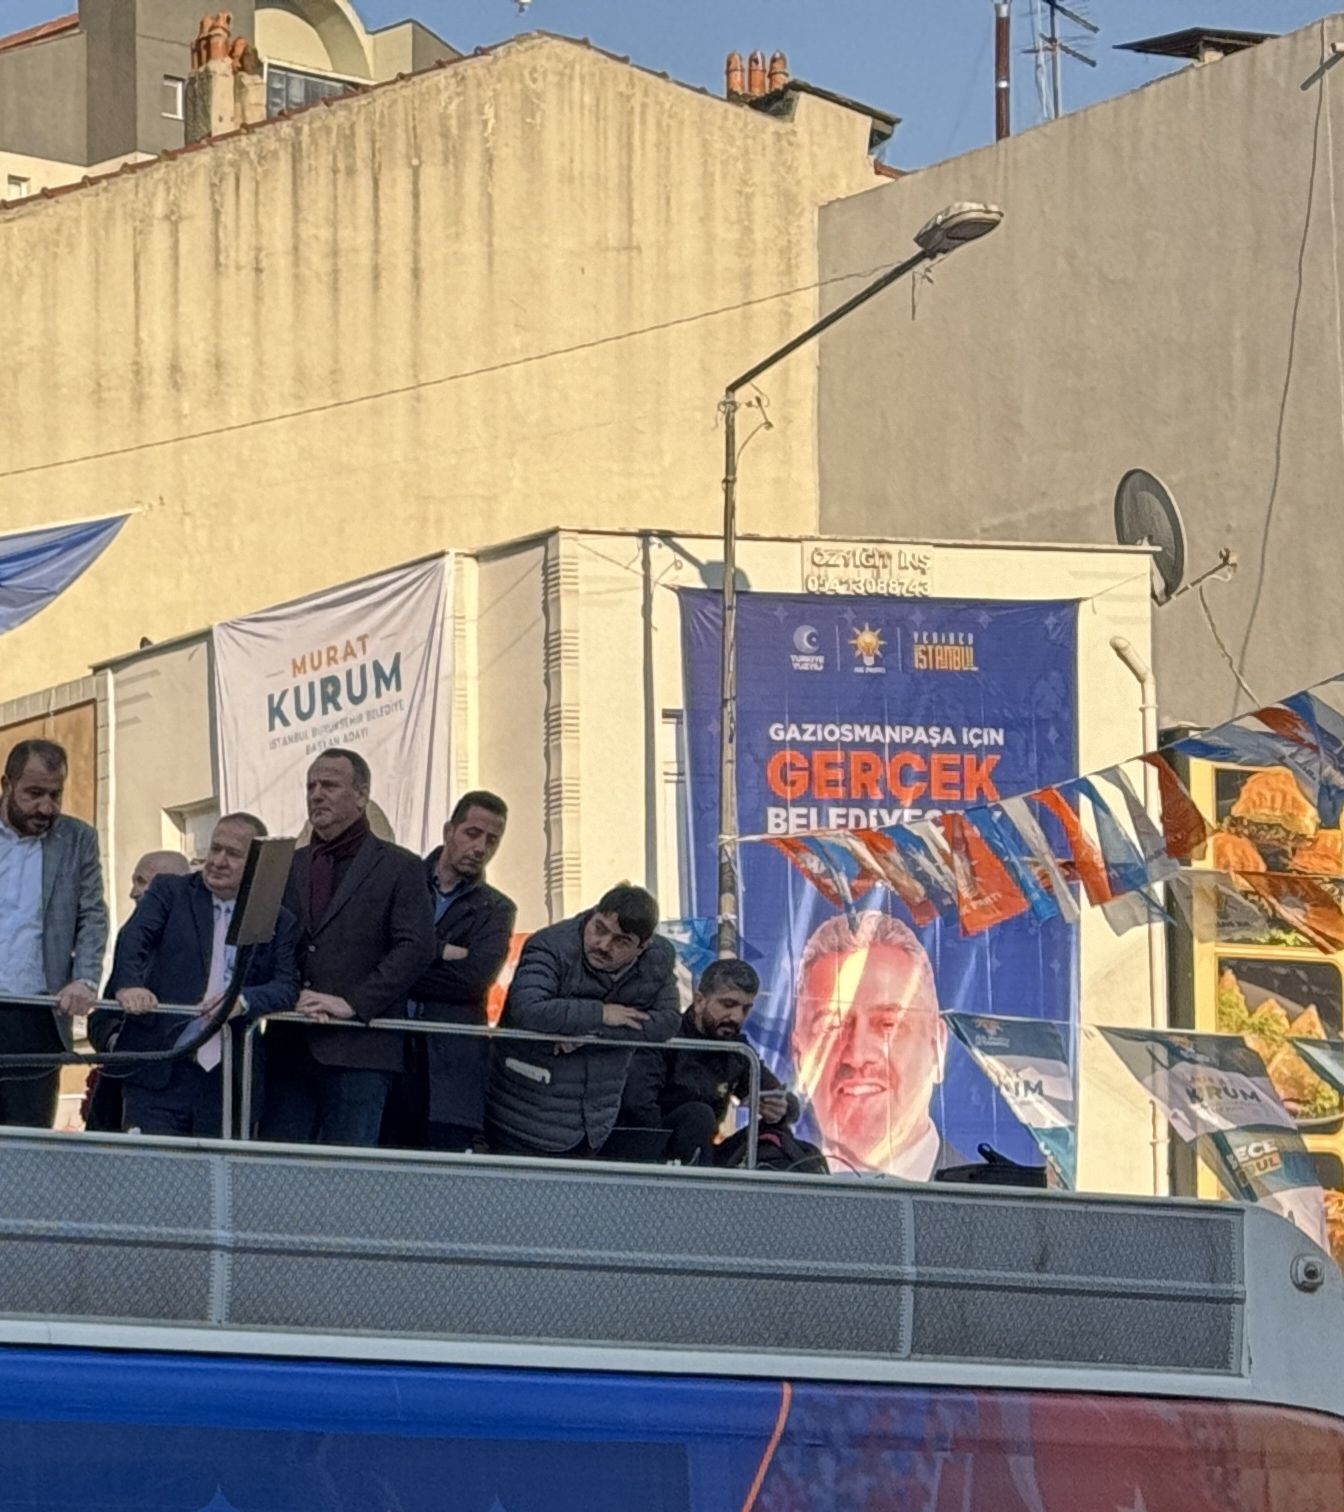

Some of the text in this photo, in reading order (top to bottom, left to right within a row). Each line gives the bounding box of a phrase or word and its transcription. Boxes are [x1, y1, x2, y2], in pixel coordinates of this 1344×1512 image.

[291, 633, 371, 678] MURAT
[267, 652, 403, 732] KURUM
[767, 750, 1001, 807] GERÇEK
